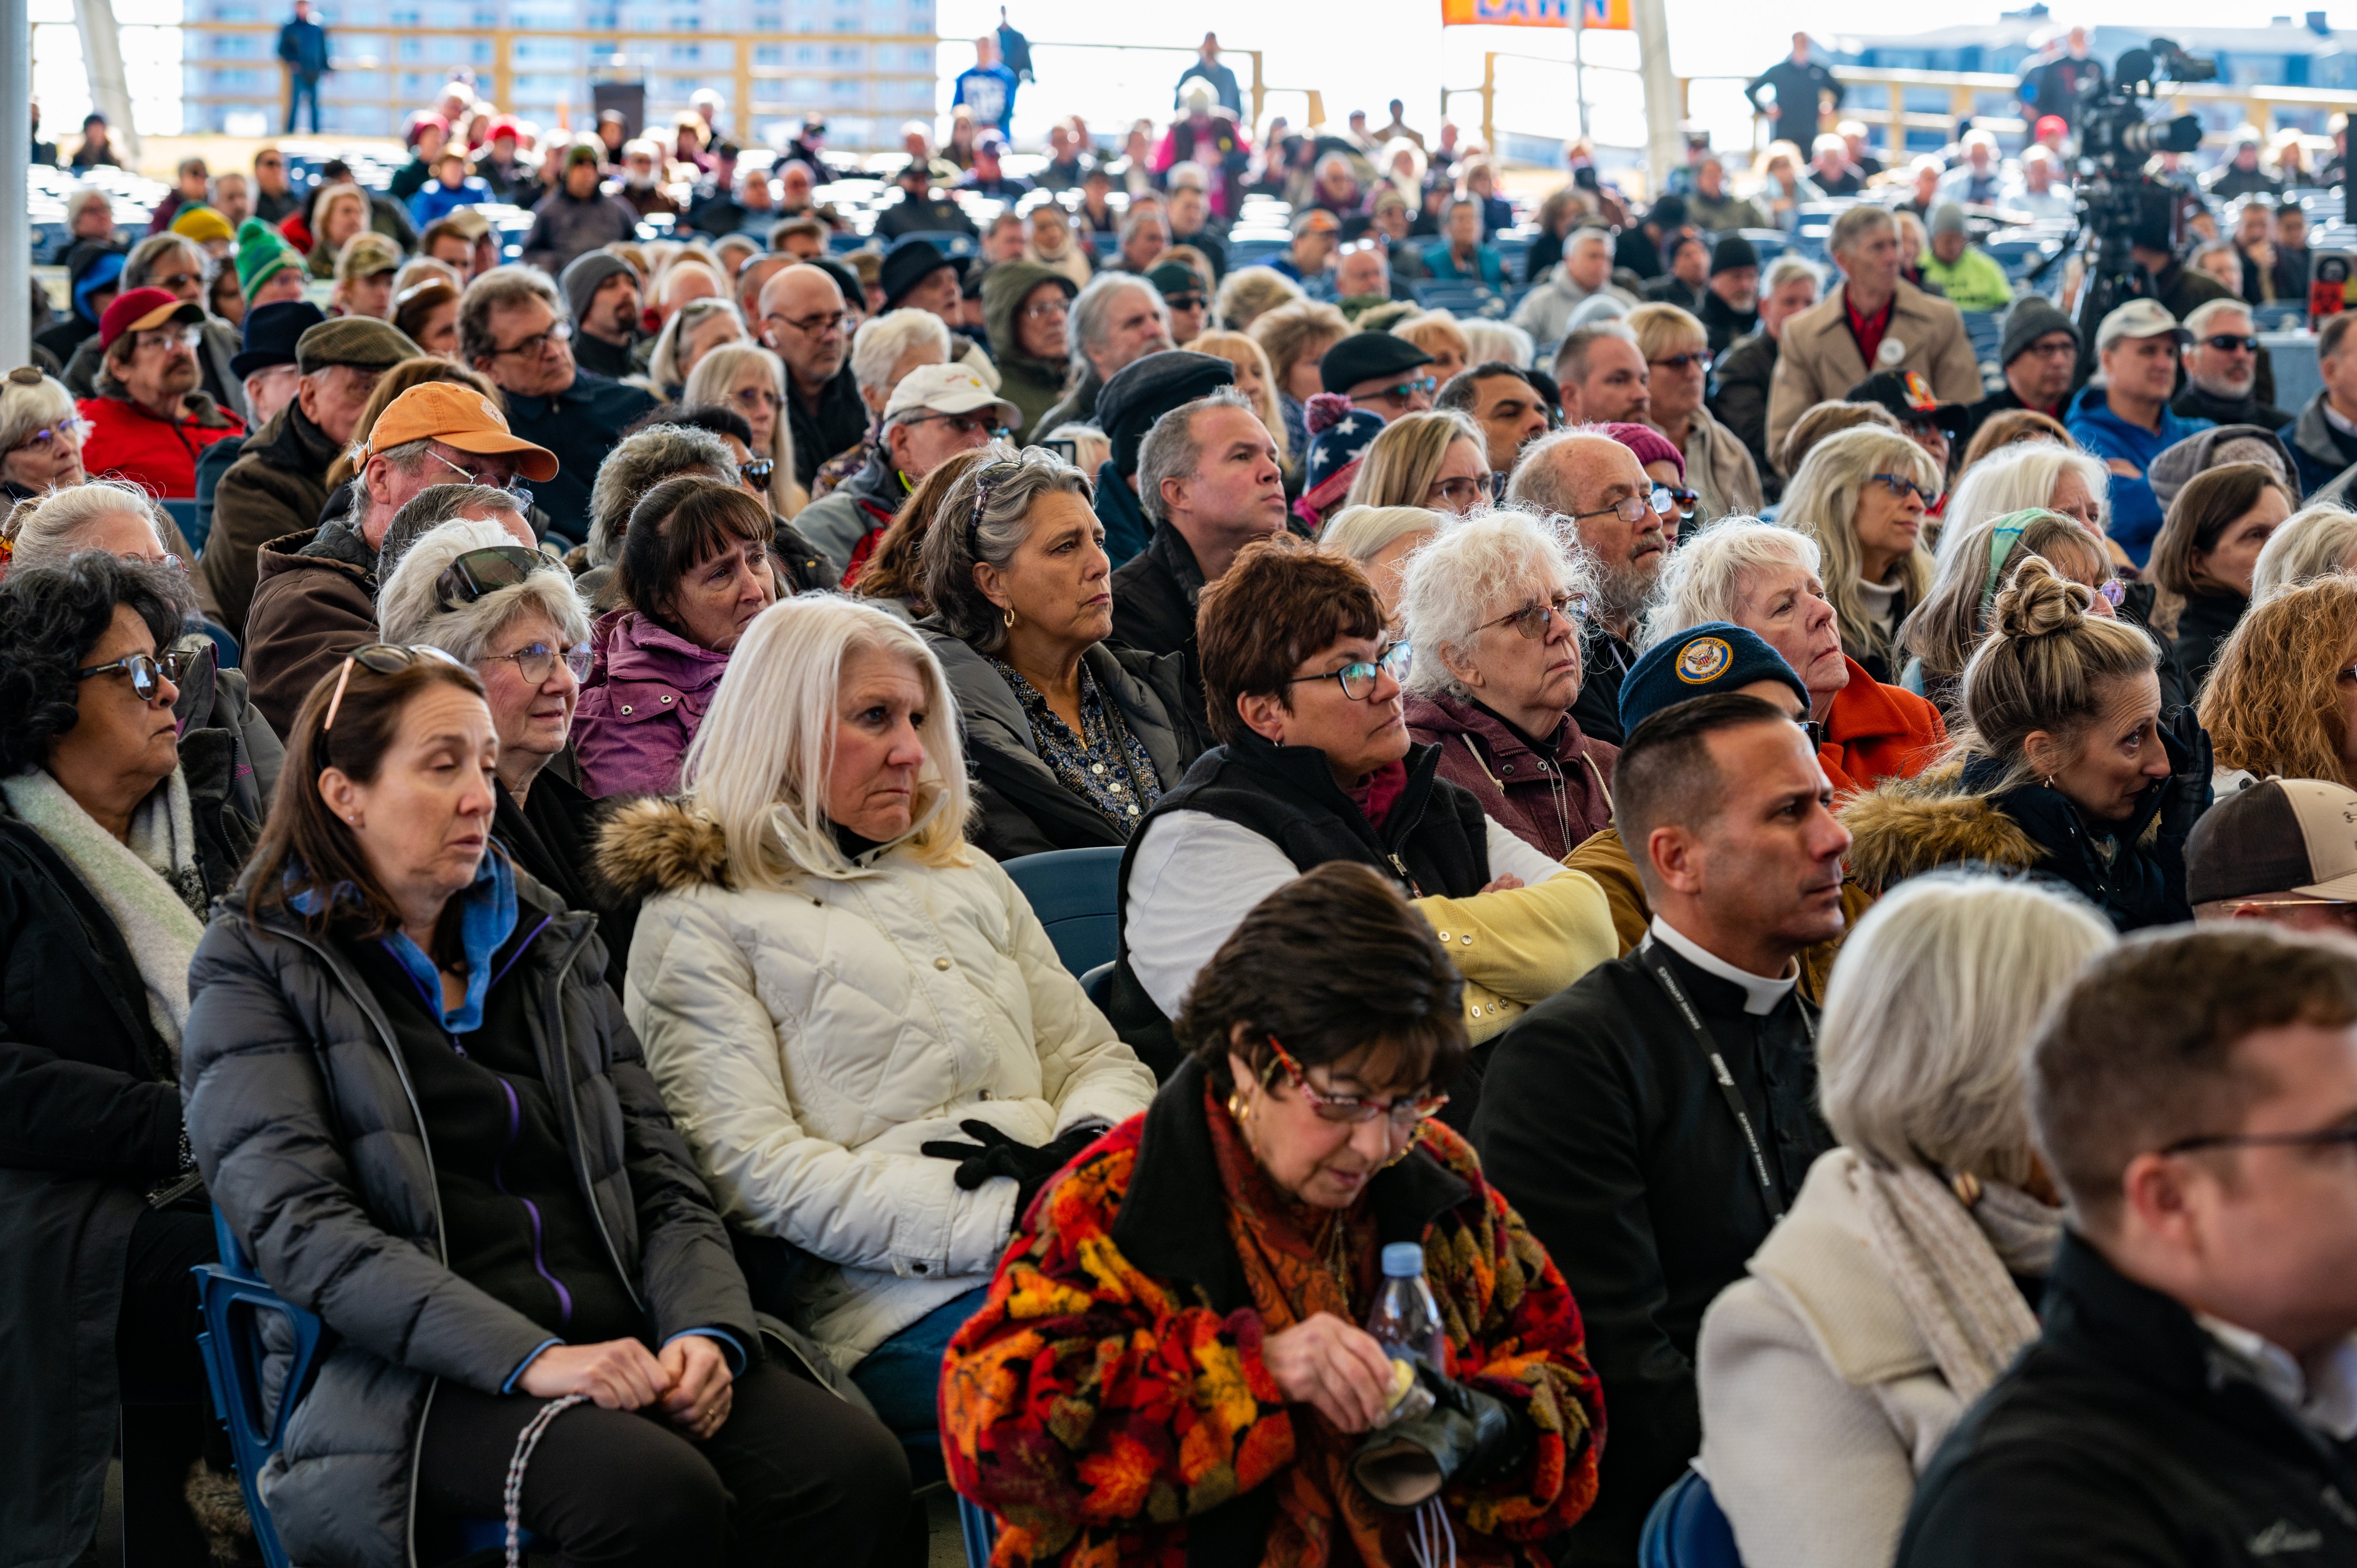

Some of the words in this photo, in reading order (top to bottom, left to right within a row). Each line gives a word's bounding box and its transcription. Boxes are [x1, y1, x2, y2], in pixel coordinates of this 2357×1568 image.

[1679, 646, 1691, 668] UNITED
[1701, 639, 1724, 648] STATES
[1701, 665, 1721, 678] NAVY
[1657, 966, 1684, 1001] CATHOLICS
[1680, 1001, 1701, 1029] SERVING
[1739, 1111, 1759, 1153] CATHOLICS
[1754, 1153, 1770, 1186] SERVING
